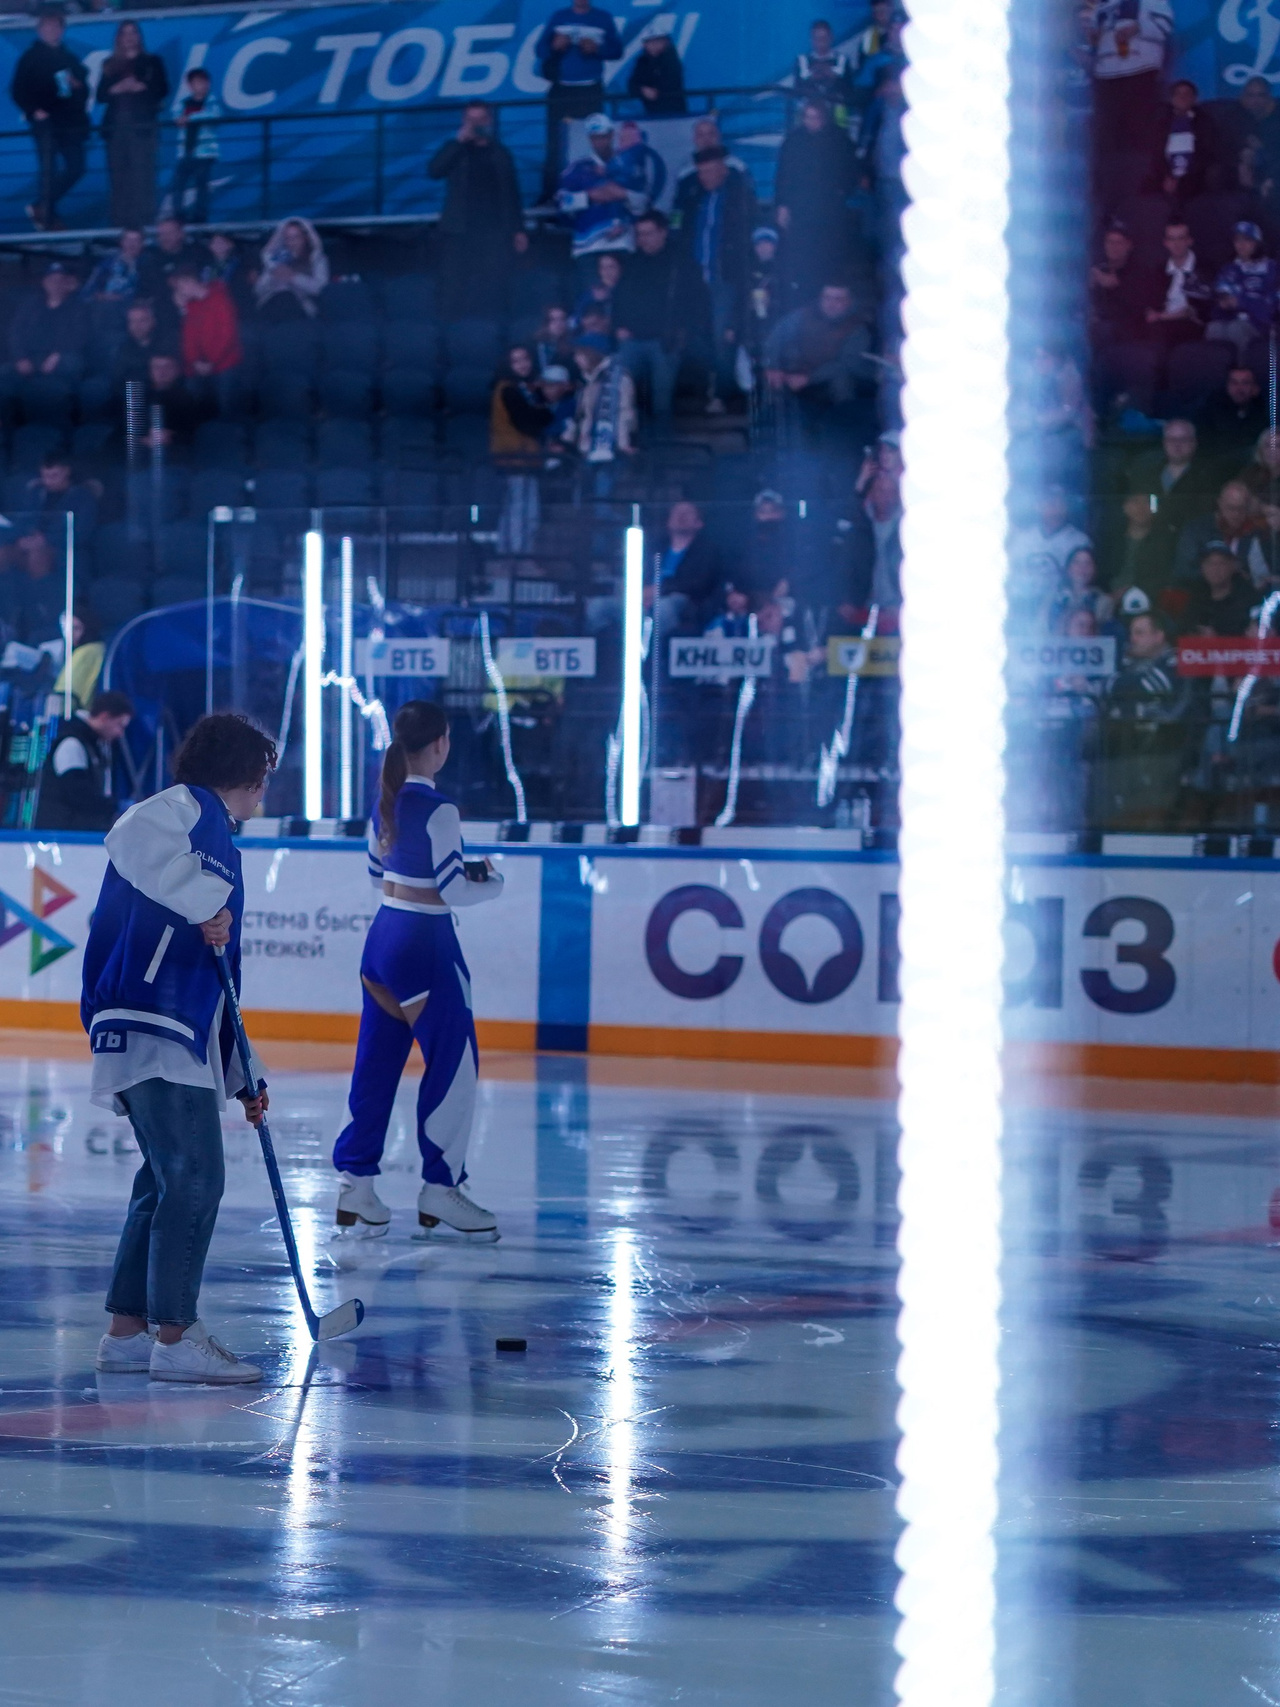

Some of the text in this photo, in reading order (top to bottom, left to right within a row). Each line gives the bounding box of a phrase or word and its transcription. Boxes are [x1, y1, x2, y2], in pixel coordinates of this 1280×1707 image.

[391, 648, 436, 671] ВТБ
[534, 648, 581, 671] ВТБ
[195, 850, 236, 880] OLIMPBET
[242, 906, 375, 932] стема быст
[240, 935, 325, 958] атежей
